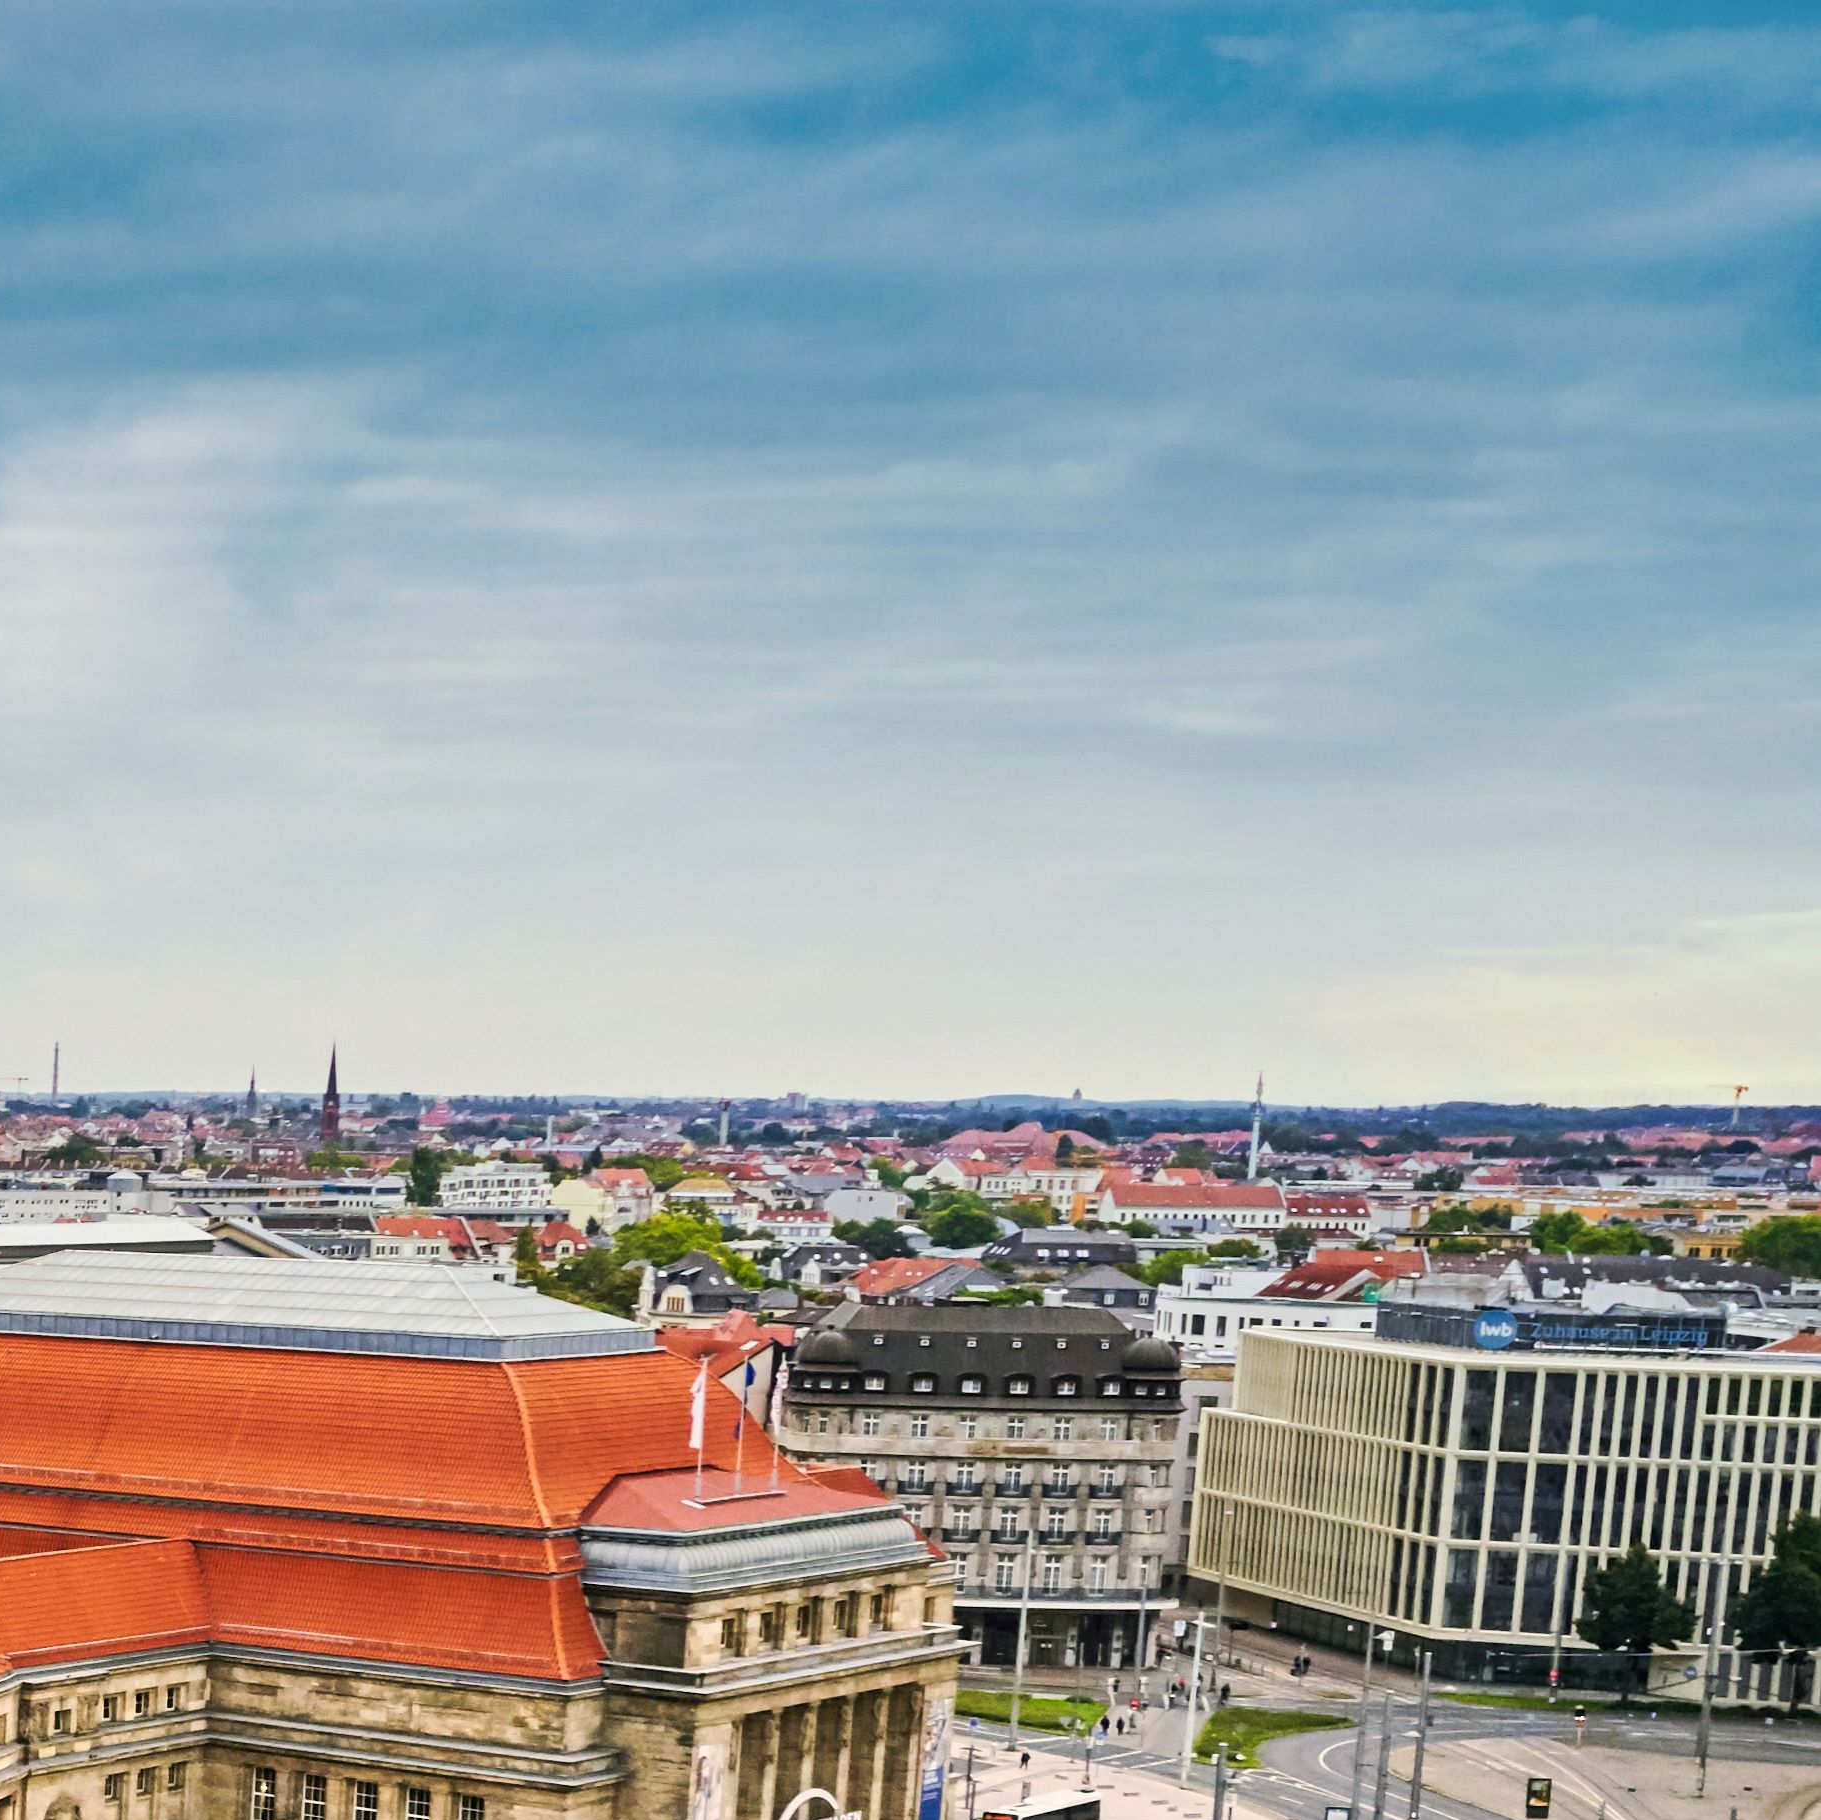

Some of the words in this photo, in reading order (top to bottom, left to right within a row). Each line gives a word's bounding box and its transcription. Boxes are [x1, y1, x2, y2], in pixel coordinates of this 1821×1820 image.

[1480, 1322, 1514, 1338] lwb
[1531, 1323, 1608, 1340] Zuhause
[1638, 1326, 1708, 1347] Leipzig
